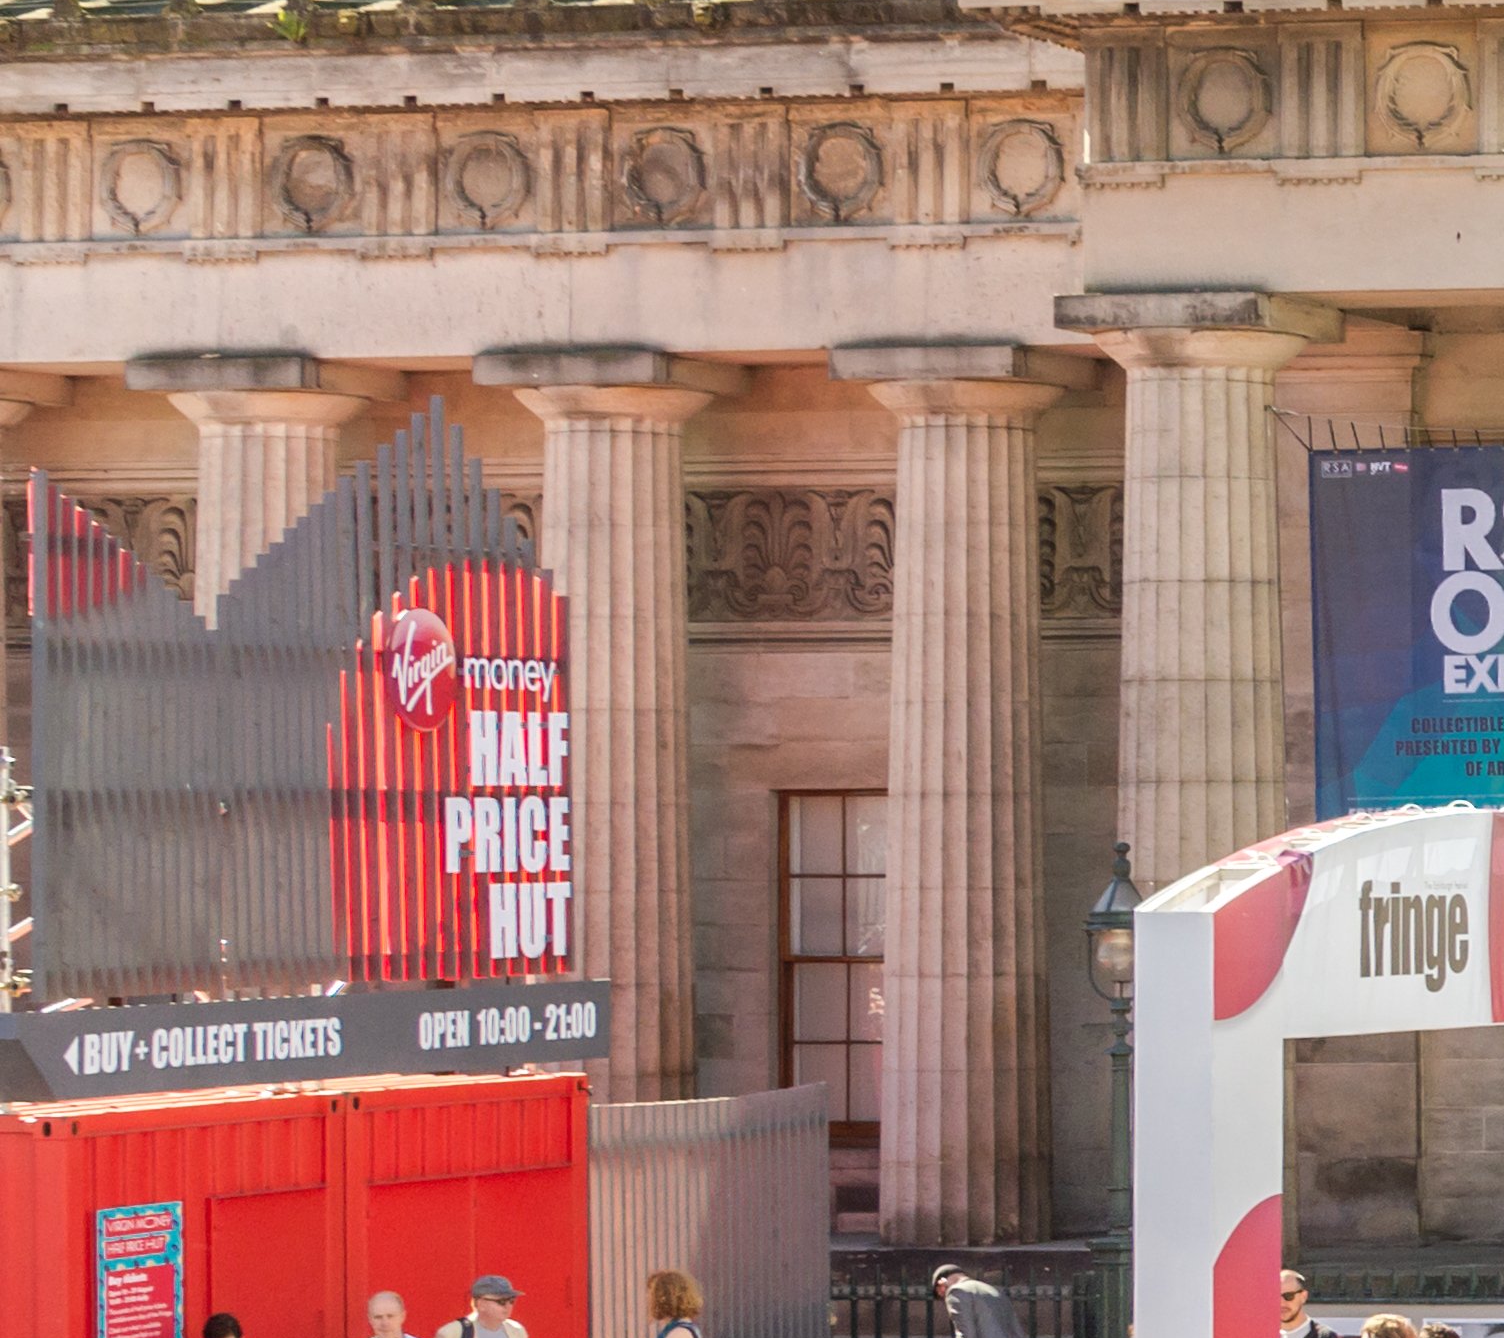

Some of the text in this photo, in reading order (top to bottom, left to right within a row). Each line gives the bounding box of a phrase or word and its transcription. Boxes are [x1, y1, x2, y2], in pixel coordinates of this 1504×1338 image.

[391, 623, 557, 716] Virgin money
[470, 711, 569, 787] HALF
[1395, 739, 1477, 756] PRESENTED
[1482, 739, 1500, 754] BY
[1411, 716, 1504, 734] COLLECTIBLE
[1465, 761, 1482, 776] OF
[445, 796, 570, 873] PRICE
[489, 882, 571, 959] HUT
[1359, 879, 1469, 993] fringe
[83, 1017, 342, 1074] BUY + COLLECT TICKETS
[419, 1008, 470, 1050] OPEN
[478, 1004, 531, 1046] 10:00
[545, 1001, 596, 1041] 21:00
